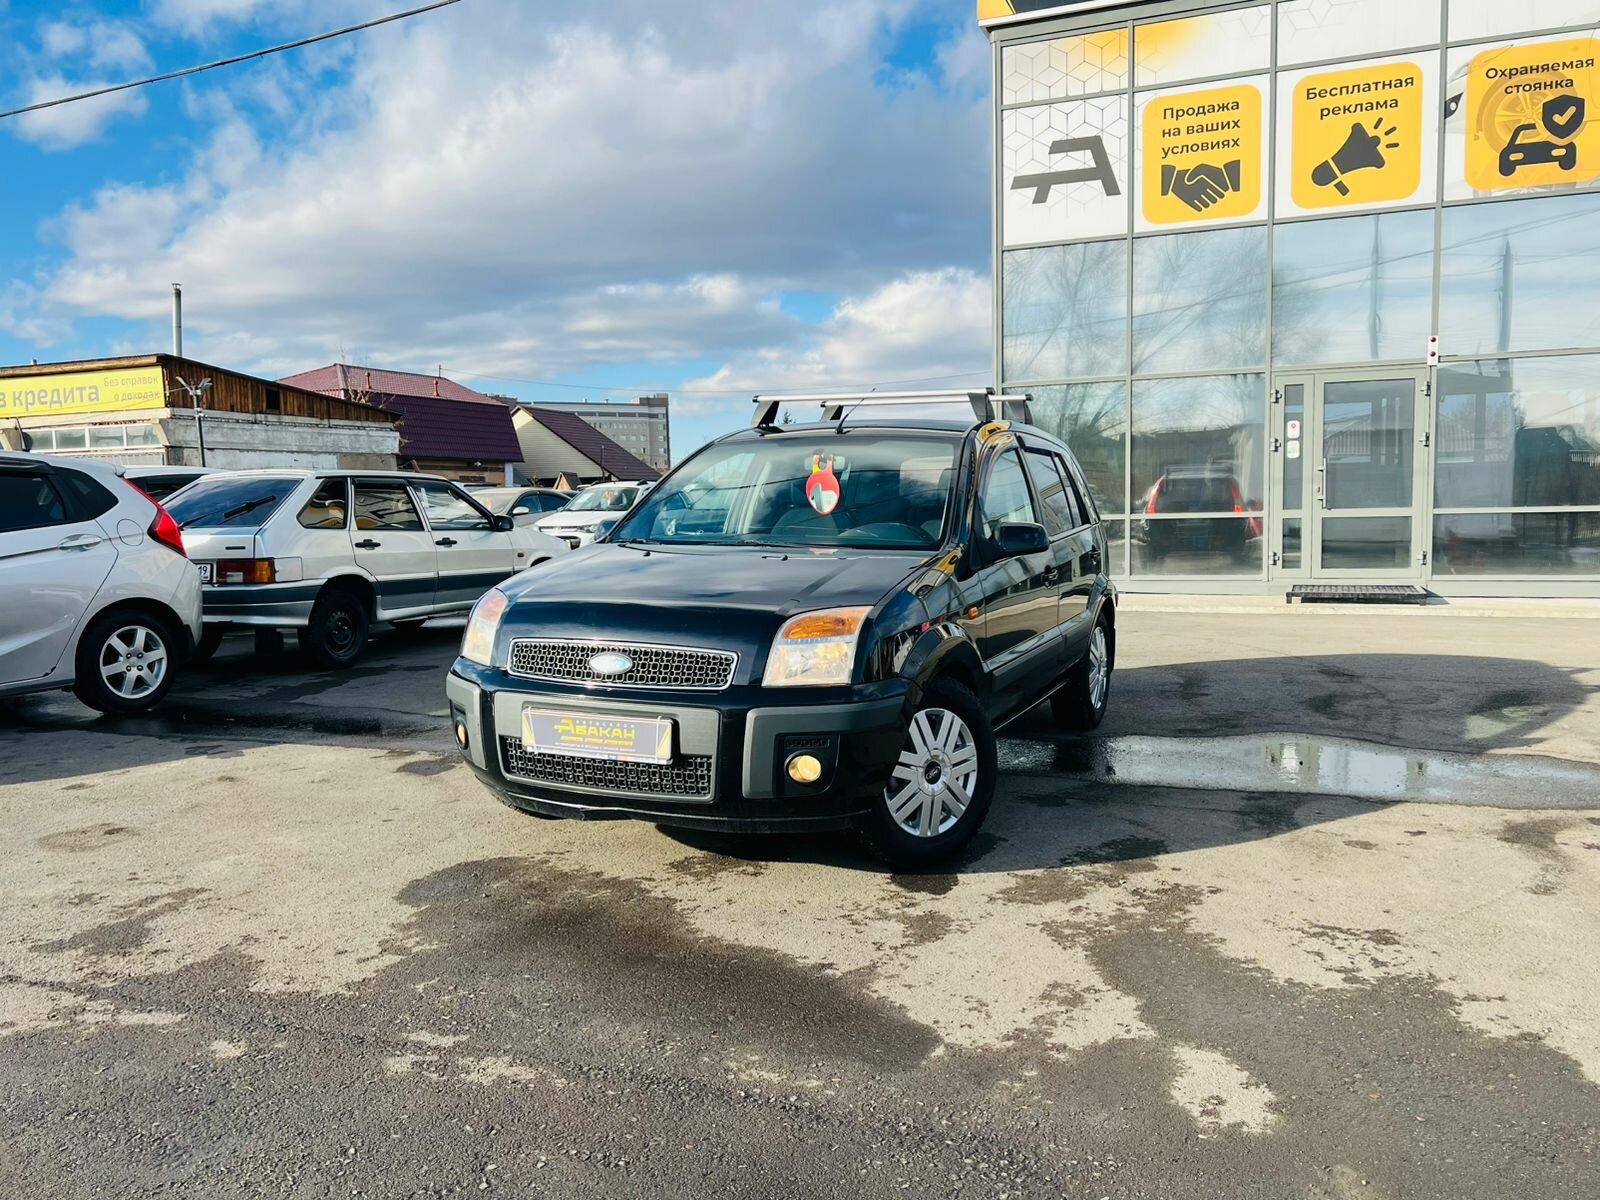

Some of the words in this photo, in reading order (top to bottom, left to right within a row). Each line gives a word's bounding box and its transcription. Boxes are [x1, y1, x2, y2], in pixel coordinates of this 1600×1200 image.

[1485, 57, 1596, 80] Охраняемая
[1305, 75, 1415, 101] Бесплатная
[1504, 78, 1574, 95] стоянка
[1162, 100, 1240, 121] Продажа
[1319, 97, 1400, 120] реклама
[1161, 126, 1181, 138] на
[1186, 119, 1241, 136] ваших
[1161, 137, 1241, 159] условиях
[103, 376, 119, 387] Без
[121, 375, 159, 388] справок
[12, 384, 100, 411] кредита
[113, 392, 120, 401] о
